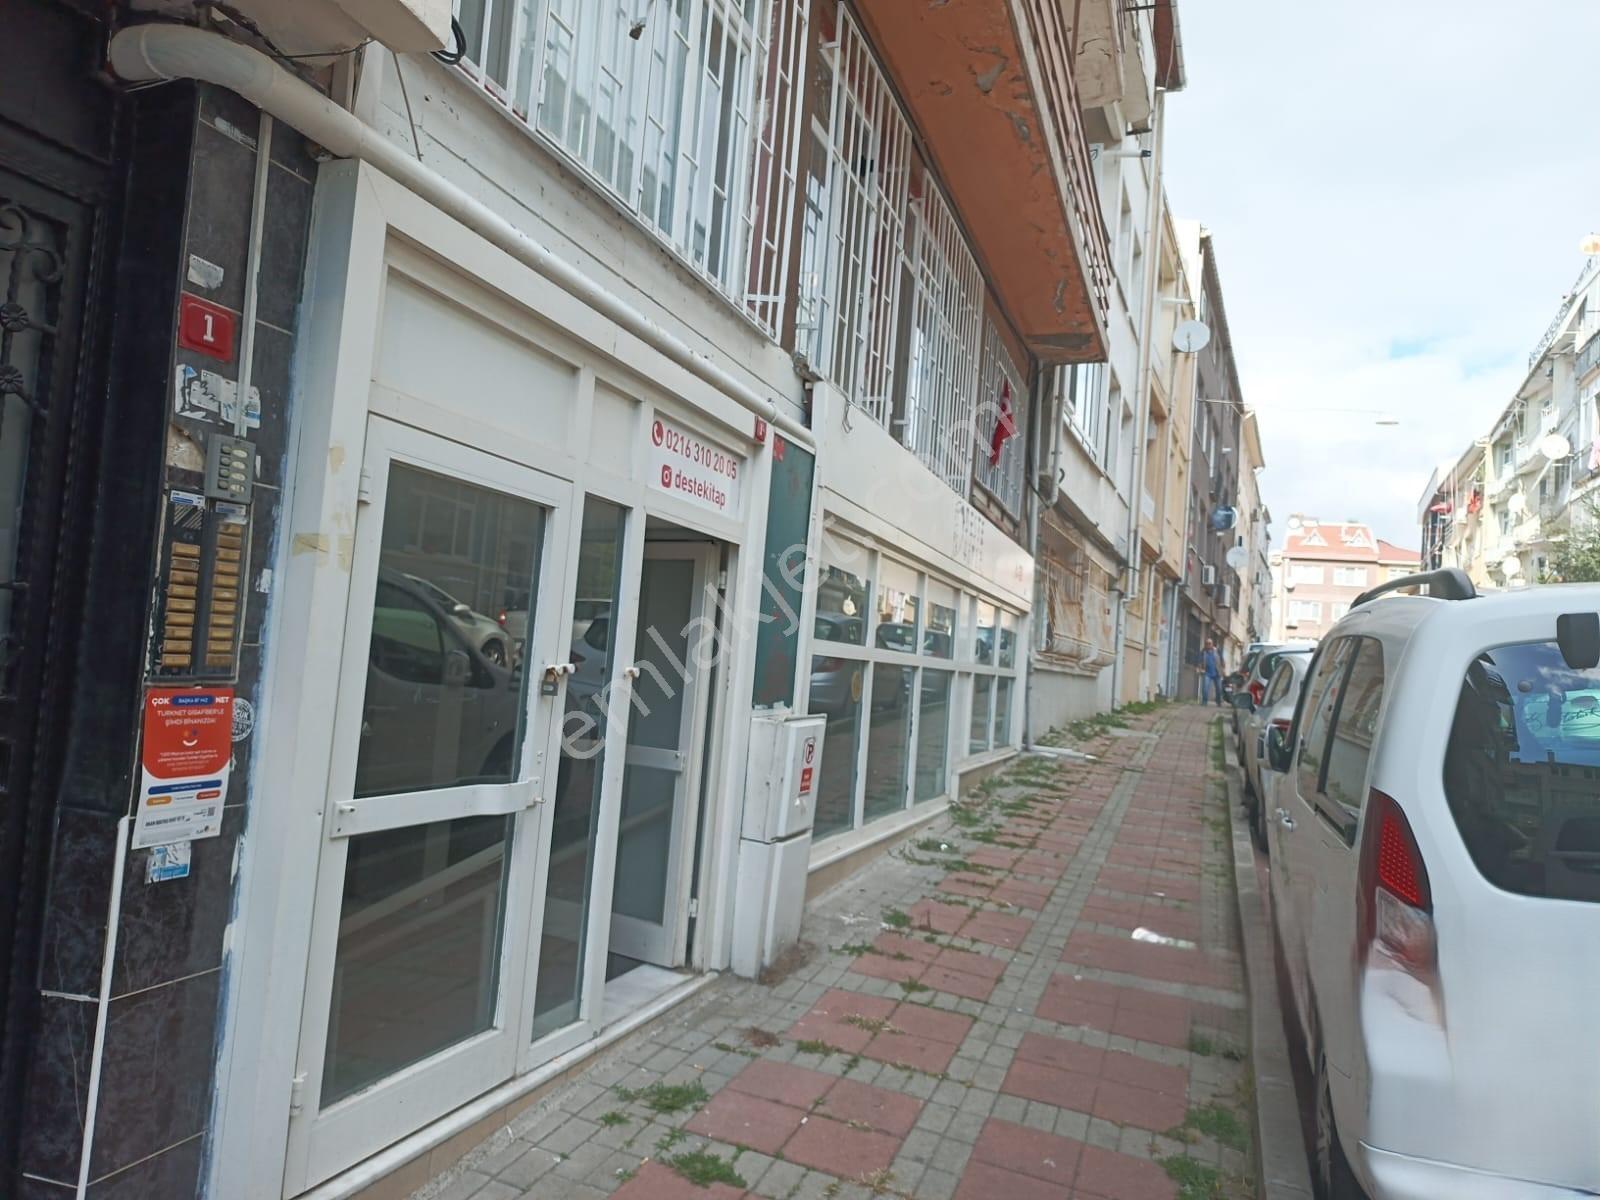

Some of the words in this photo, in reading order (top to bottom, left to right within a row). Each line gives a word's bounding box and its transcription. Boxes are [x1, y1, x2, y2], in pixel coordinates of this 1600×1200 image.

[203, 315, 214, 342] 1
[666, 429, 691, 458] 0216
[694, 444, 711, 468] 310
[714, 453, 724, 474] 20
[726, 459, 737, 480] 05
[675, 470, 726, 509] destekitap
[215, 696, 230, 704] NET
